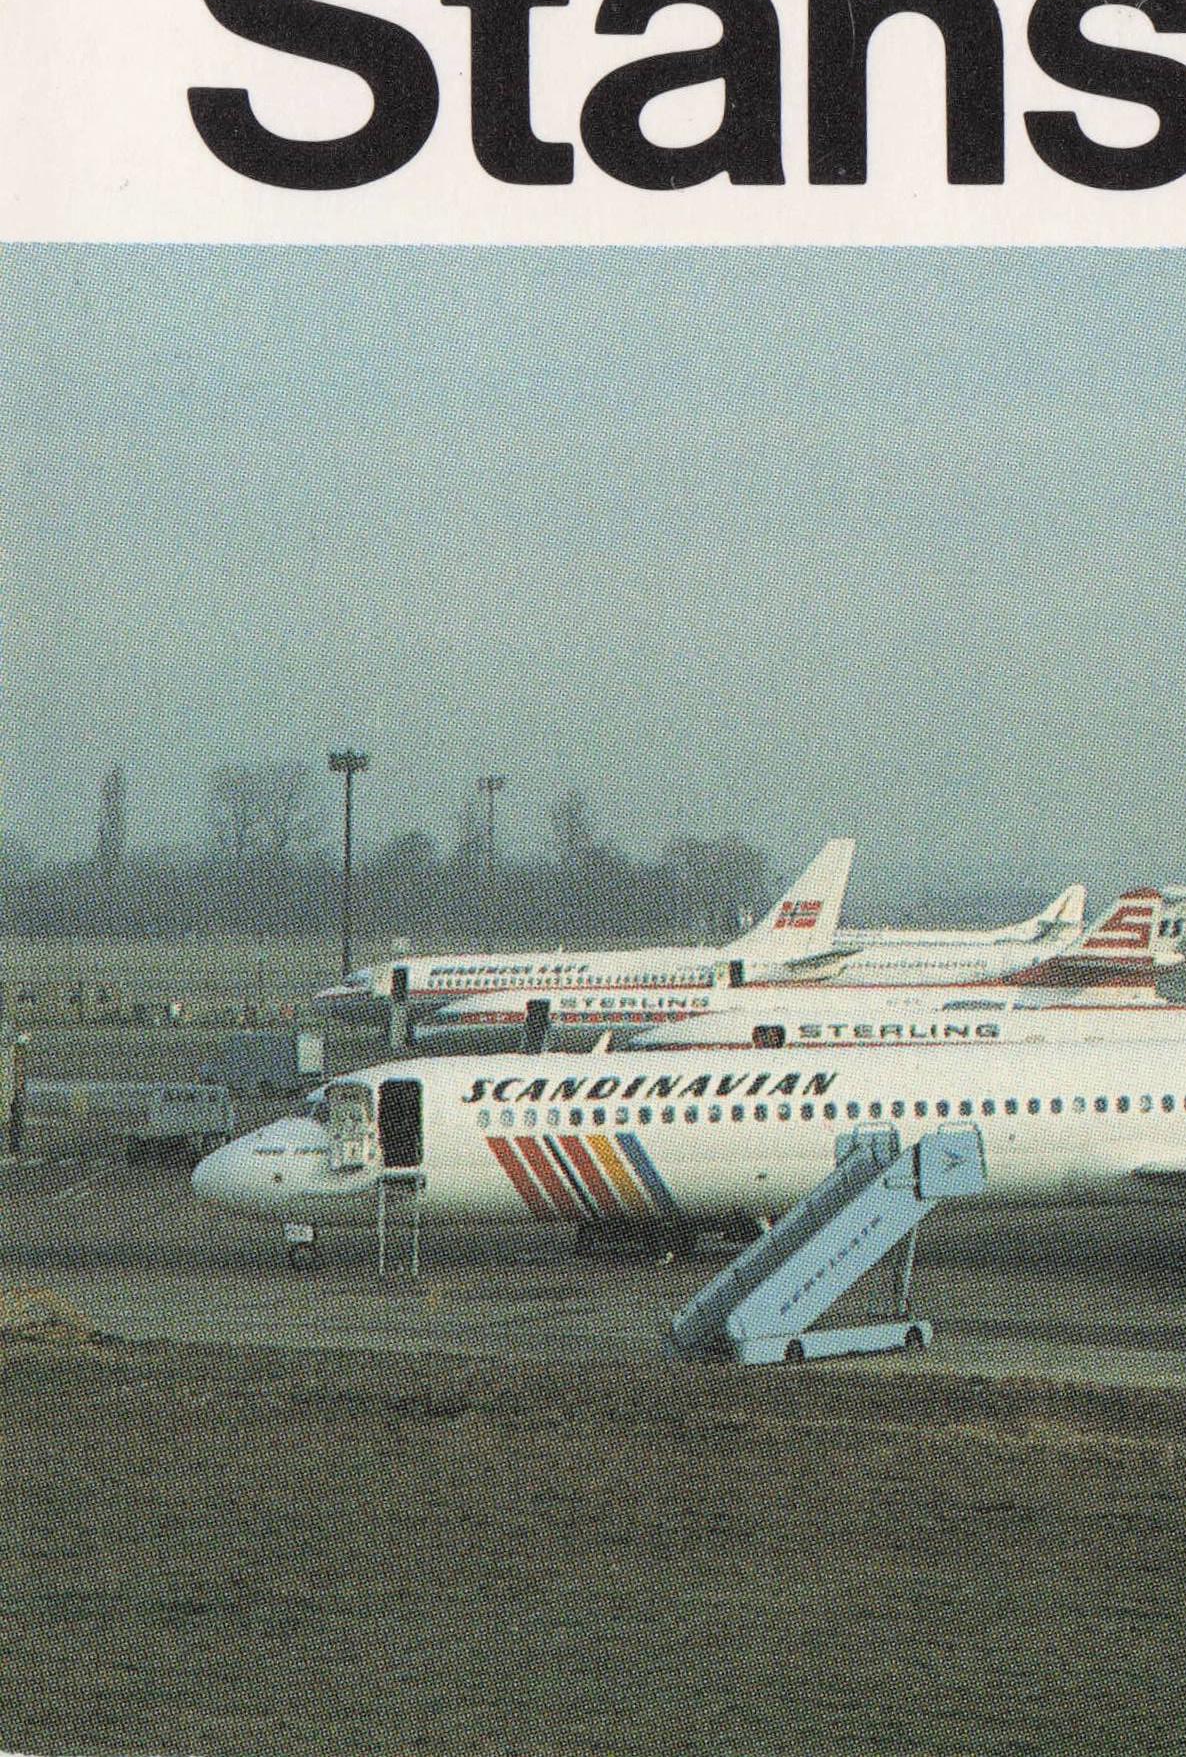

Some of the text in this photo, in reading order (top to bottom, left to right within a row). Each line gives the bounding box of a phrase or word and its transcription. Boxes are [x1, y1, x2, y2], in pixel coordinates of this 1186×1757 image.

[560, 995, 711, 1009] STERLING
[799, 1023, 1001, 1040] STERLING
[462, 1072, 838, 1104] SCANDINAVIAN
